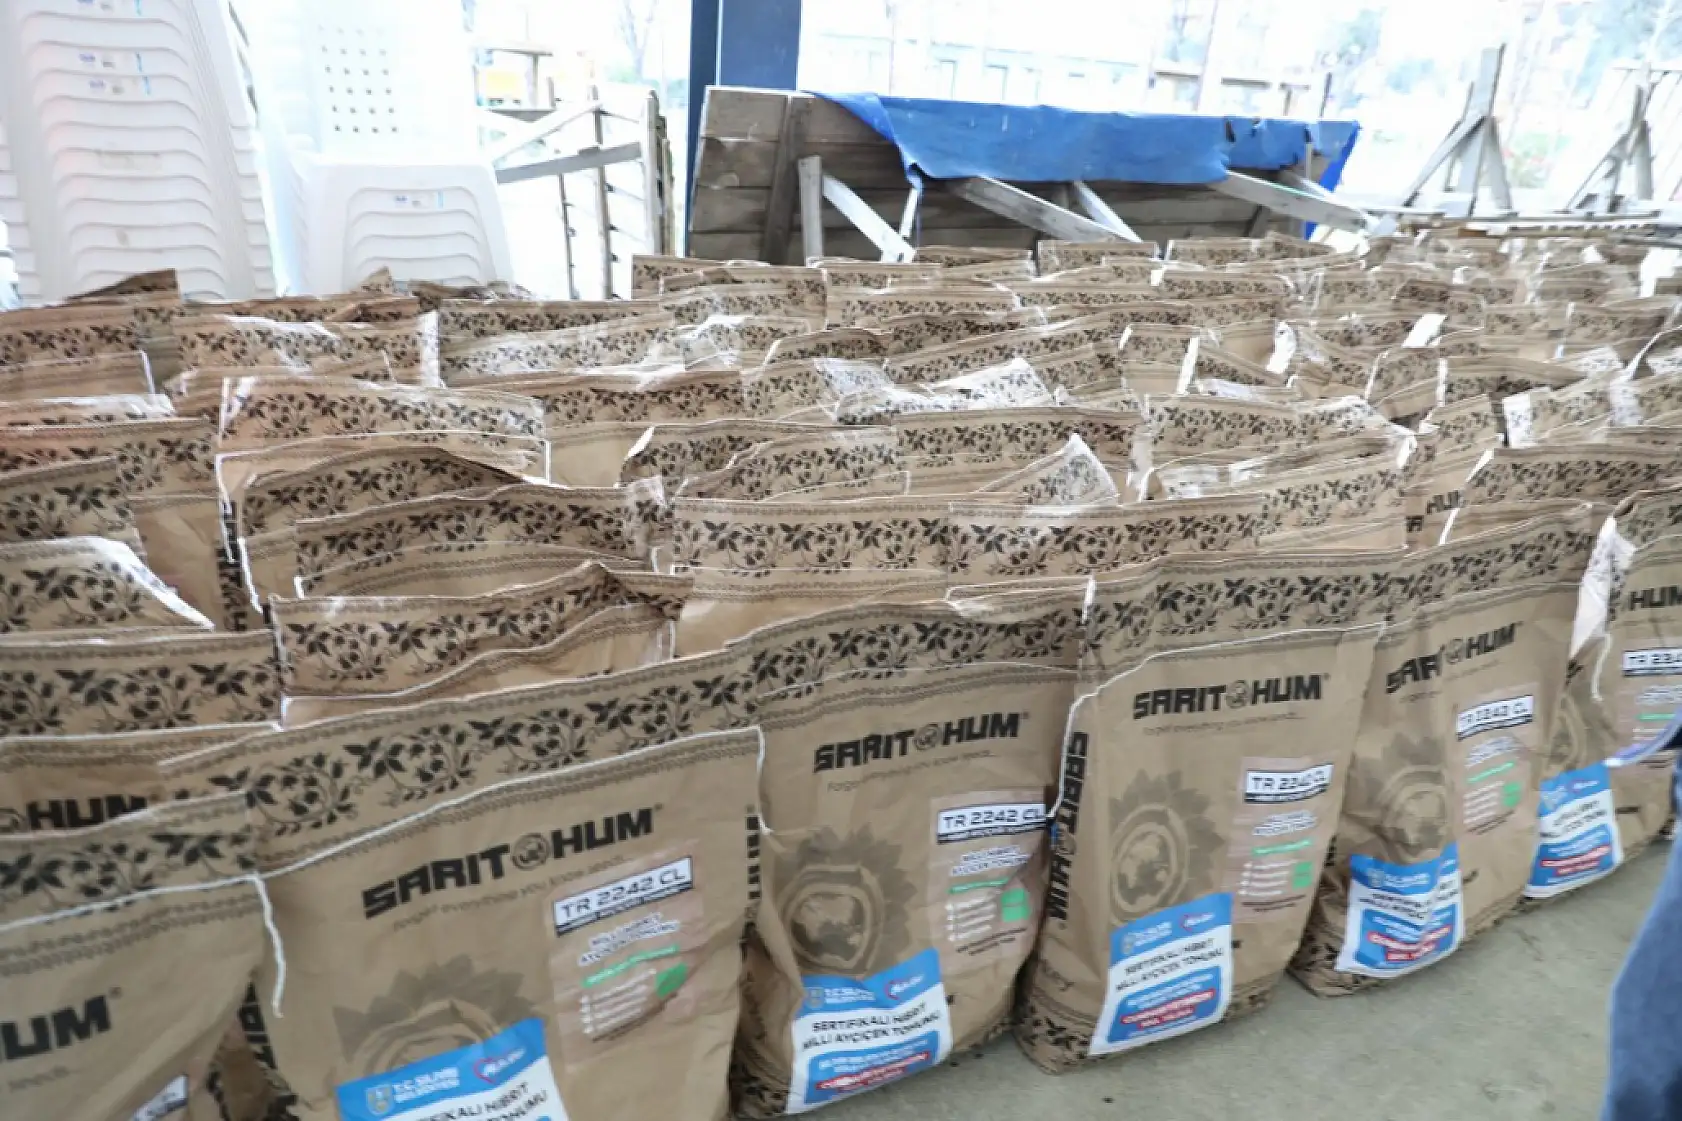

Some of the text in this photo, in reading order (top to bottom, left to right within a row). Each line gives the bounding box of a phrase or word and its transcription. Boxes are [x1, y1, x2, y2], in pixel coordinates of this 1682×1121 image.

[1133, 675, 1321, 720] SARIT HUM
[814, 730, 914, 773] SARIT
[942, 712, 1020, 746] HUM
[943, 815, 967, 829] TR
[969, 808, 1018, 826] 2242
[362, 807, 654, 919] SARIT HUM
[560, 897, 590, 919] TR
[597, 875, 655, 906] 2242
[658, 866, 686, 885] CL
[0, 994, 111, 1060] UM
